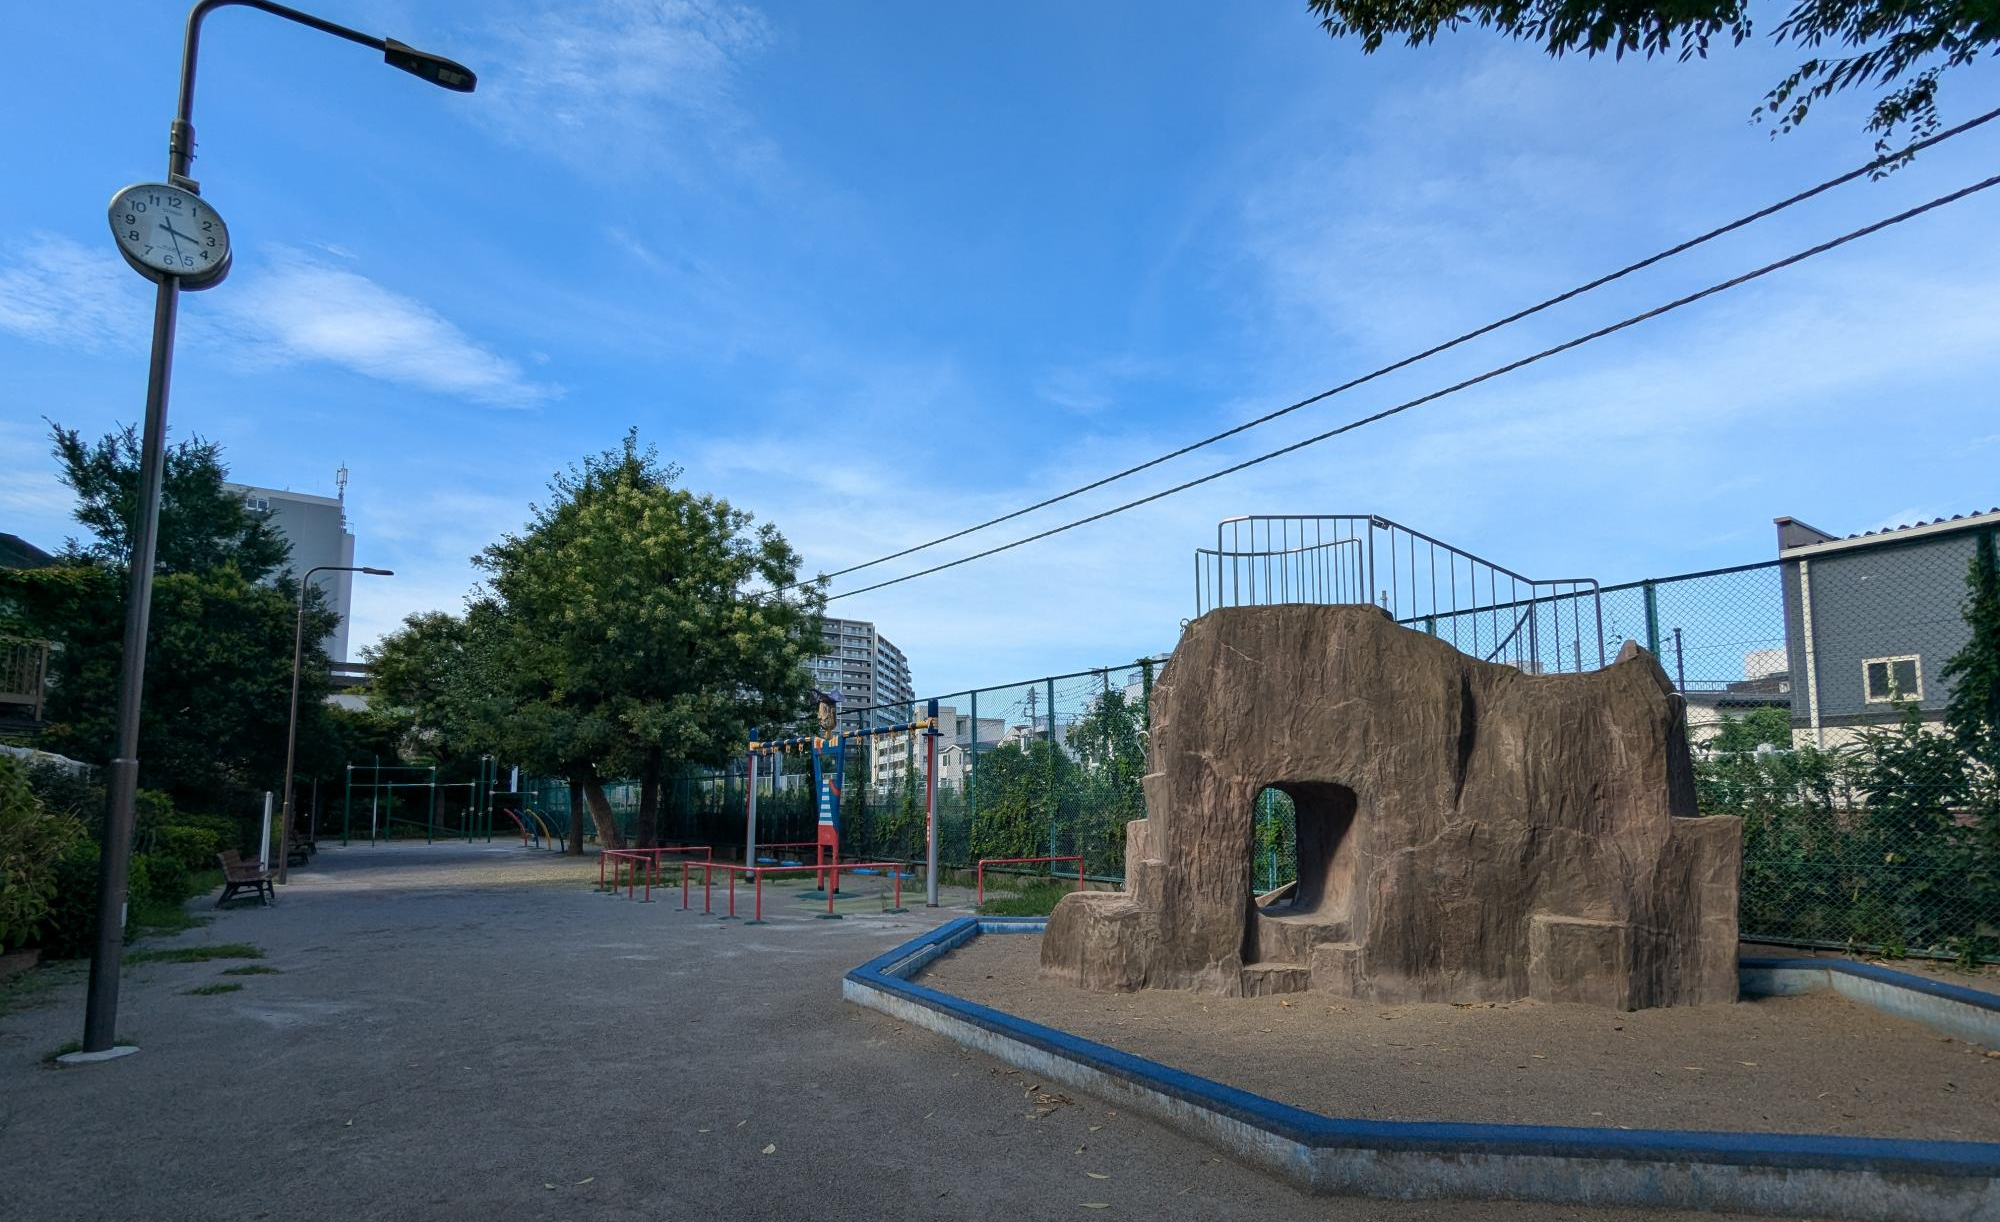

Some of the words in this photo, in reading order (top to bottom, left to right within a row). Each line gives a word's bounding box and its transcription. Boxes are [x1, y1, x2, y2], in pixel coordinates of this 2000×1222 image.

[148, 194, 160, 206] 11
[167, 196, 182, 208] 12
[130, 200, 146, 212] 10
[192, 208, 196, 218] 1
[125, 214, 136, 225] 9
[202, 221, 212, 232] 2
[129, 230, 140, 241] 8
[206, 236, 216, 247] 3
[144, 244, 154, 255] 7
[199, 250, 209, 260] 4
[163, 255, 174, 265] 6
[184, 256, 194, 266] 5
